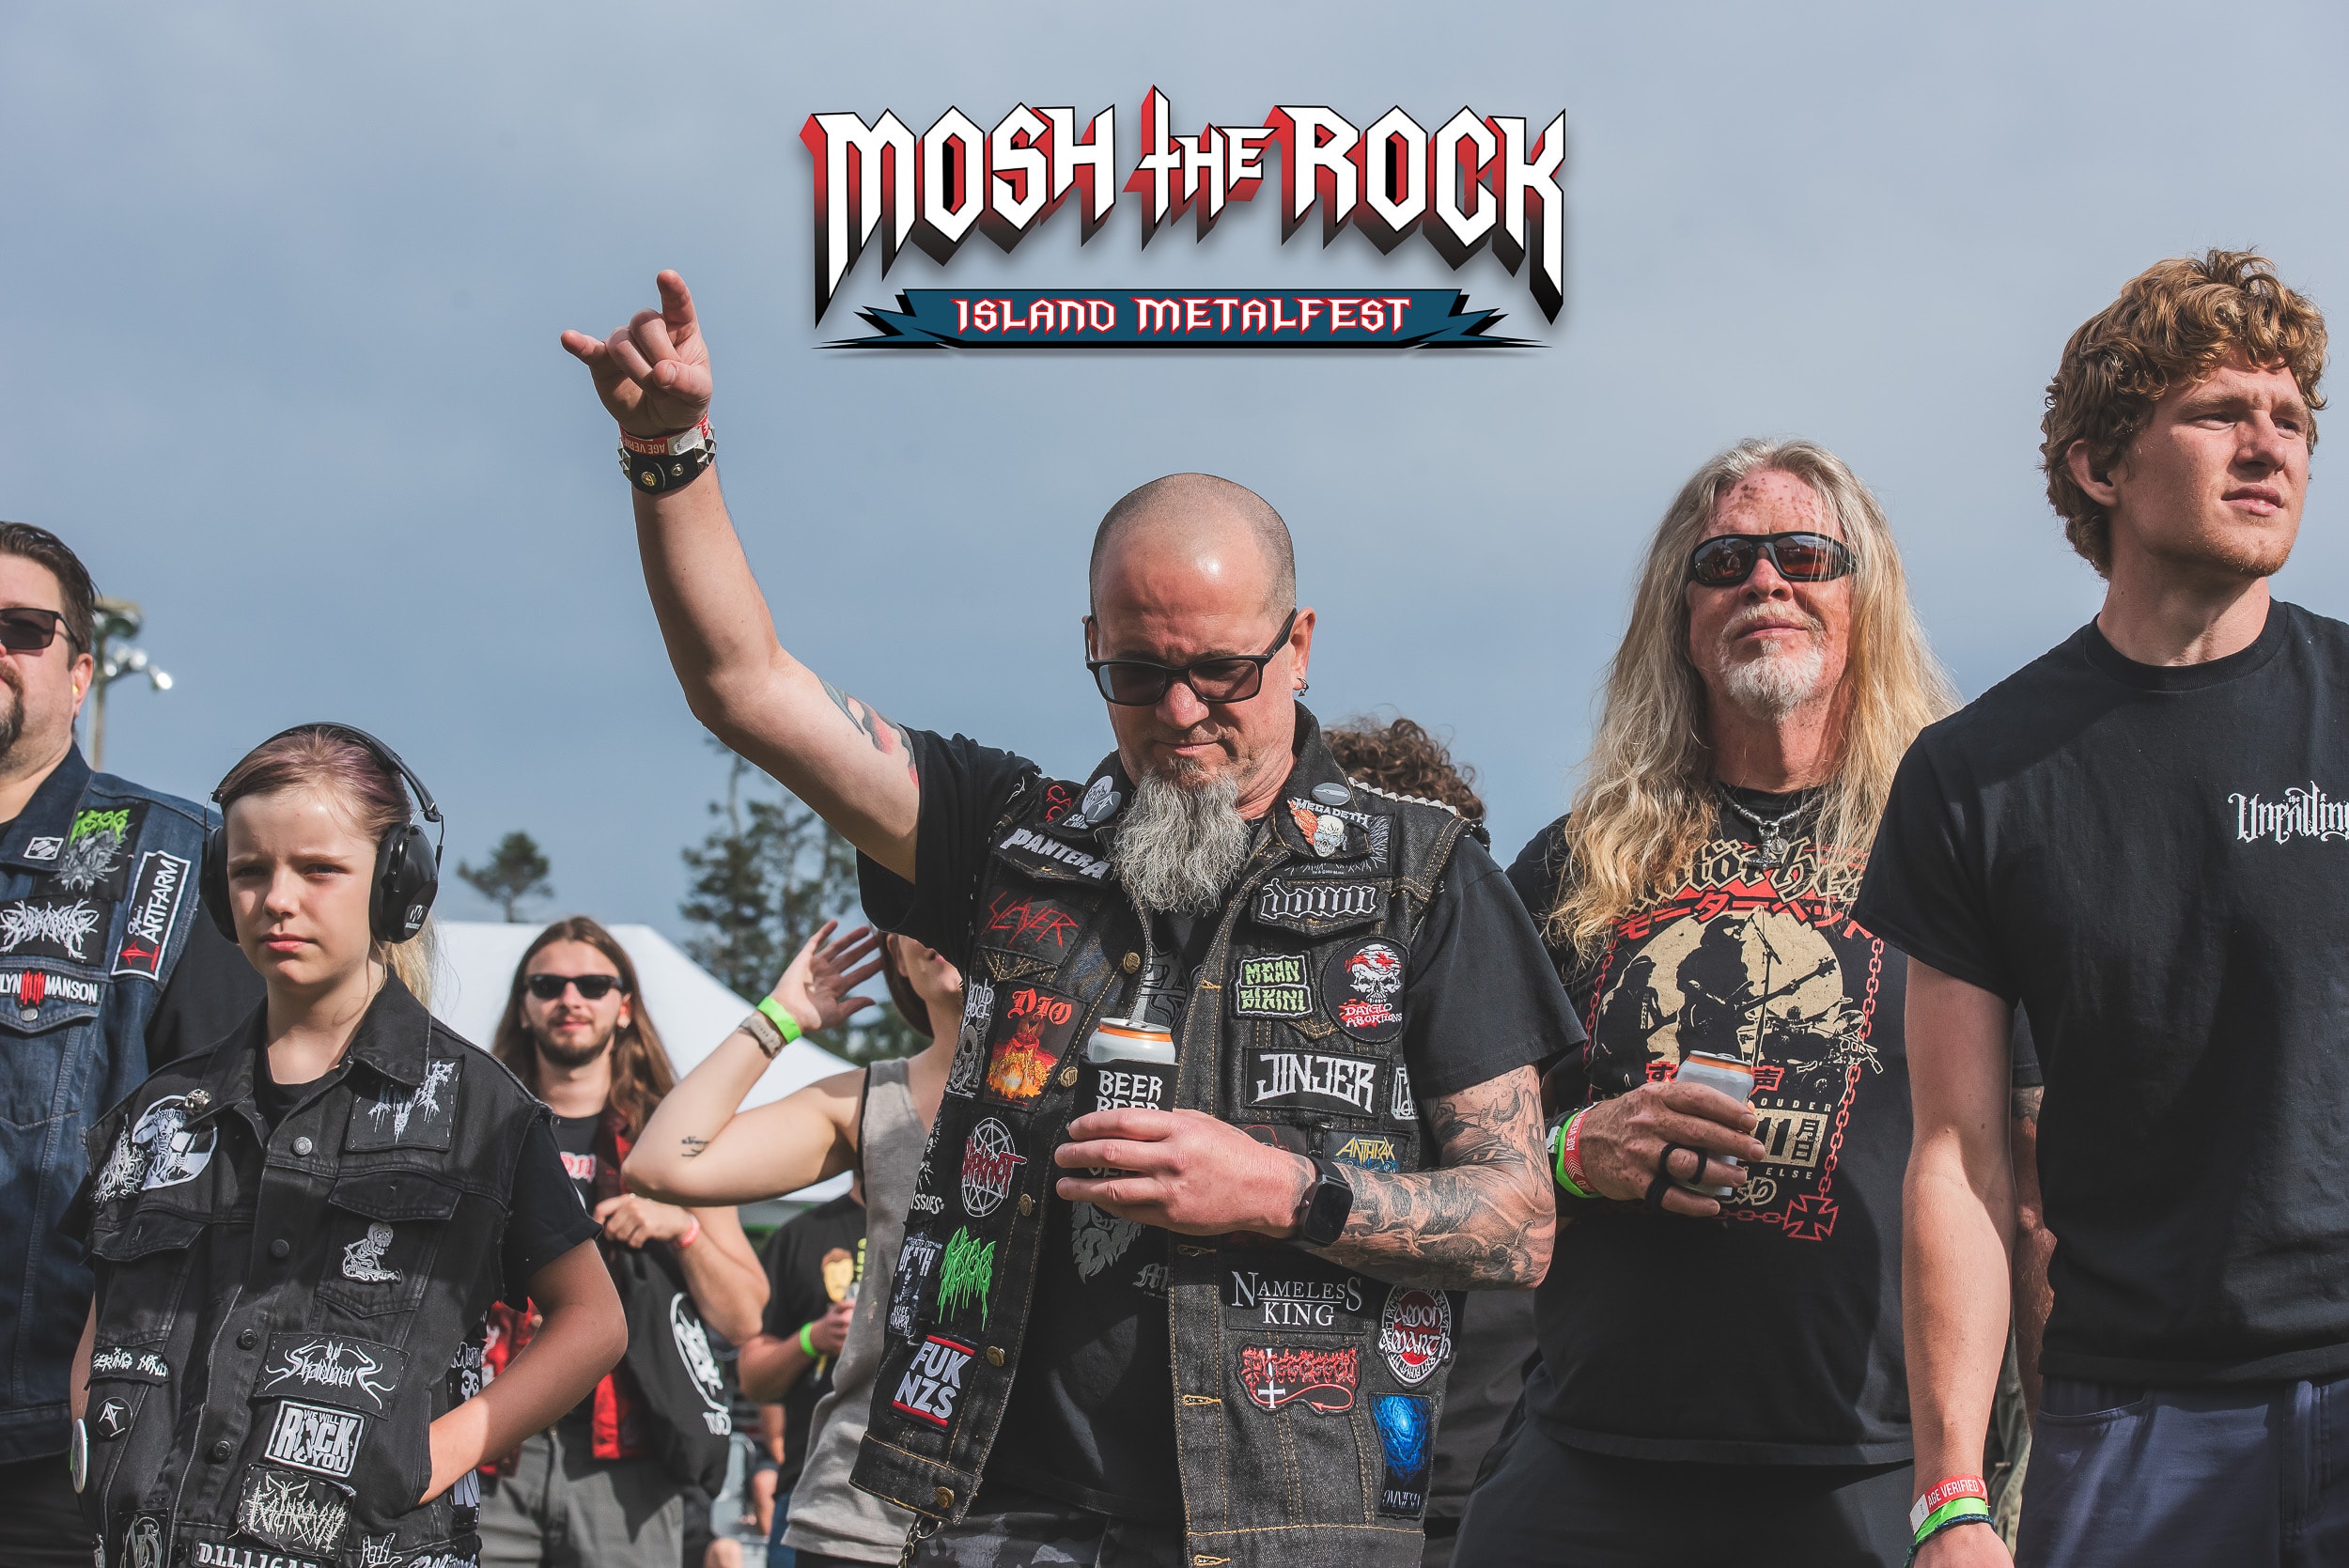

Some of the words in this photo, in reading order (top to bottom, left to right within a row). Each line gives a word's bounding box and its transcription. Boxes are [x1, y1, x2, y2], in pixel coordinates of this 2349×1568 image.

[1292, 797, 1373, 830] MEGADETH
[2227, 780, 2349, 846] Unendin
[999, 828, 1111, 879] PANTERA
[140, 858, 179, 945] ARTFARM
[980, 891, 1079, 951] SLAYER
[1243, 959, 1301, 986] MEAN
[44, 973, 98, 1003] MANSON
[1239, 985, 1306, 1013] BIKINI
[1345, 1002, 1393, 1017] DAYGLO
[1346, 1012, 1403, 1028] ABORTIONS
[1098, 1069, 1163, 1102] BEER
[1254, 1052, 1378, 1114] JINJER
[1753, 1098, 1832, 1112] OUDER
[1335, 1136, 1396, 1165] ANTHRAX
[1766, 1168, 1813, 1180] ELSE
[1263, 1303, 1335, 1327] KING
[910, 1341, 972, 1390] FUK
[894, 1375, 957, 1421] NZS
[303, 1410, 319, 1421] WE
[319, 1411, 339, 1425] WILL
[273, 1407, 358, 1463] ROCK
[312, 1450, 349, 1472] YOU
[1928, 1490, 1940, 1508] AGE
[1941, 1479, 1980, 1498] VERIFIED
